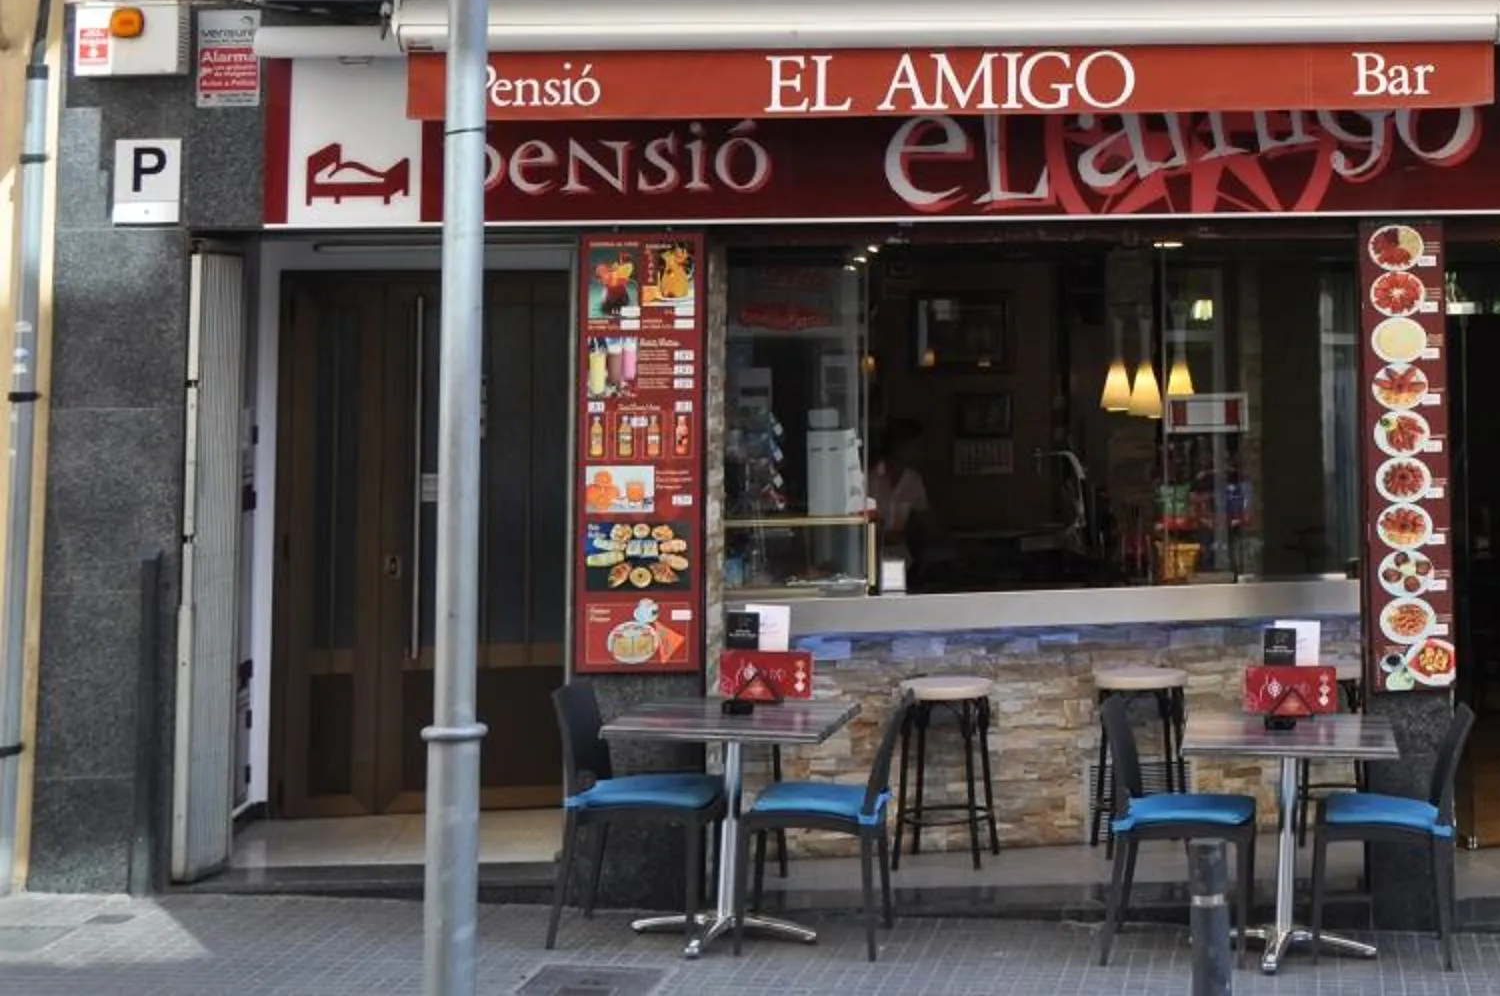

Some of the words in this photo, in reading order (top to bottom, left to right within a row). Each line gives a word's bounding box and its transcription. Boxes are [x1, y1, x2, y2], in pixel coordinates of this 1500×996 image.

[764, 55, 852, 113] EL
[876, 50, 1135, 111] AMIGO
[1352, 52, 1435, 97] Bar
[132, 147, 167, 193] P
